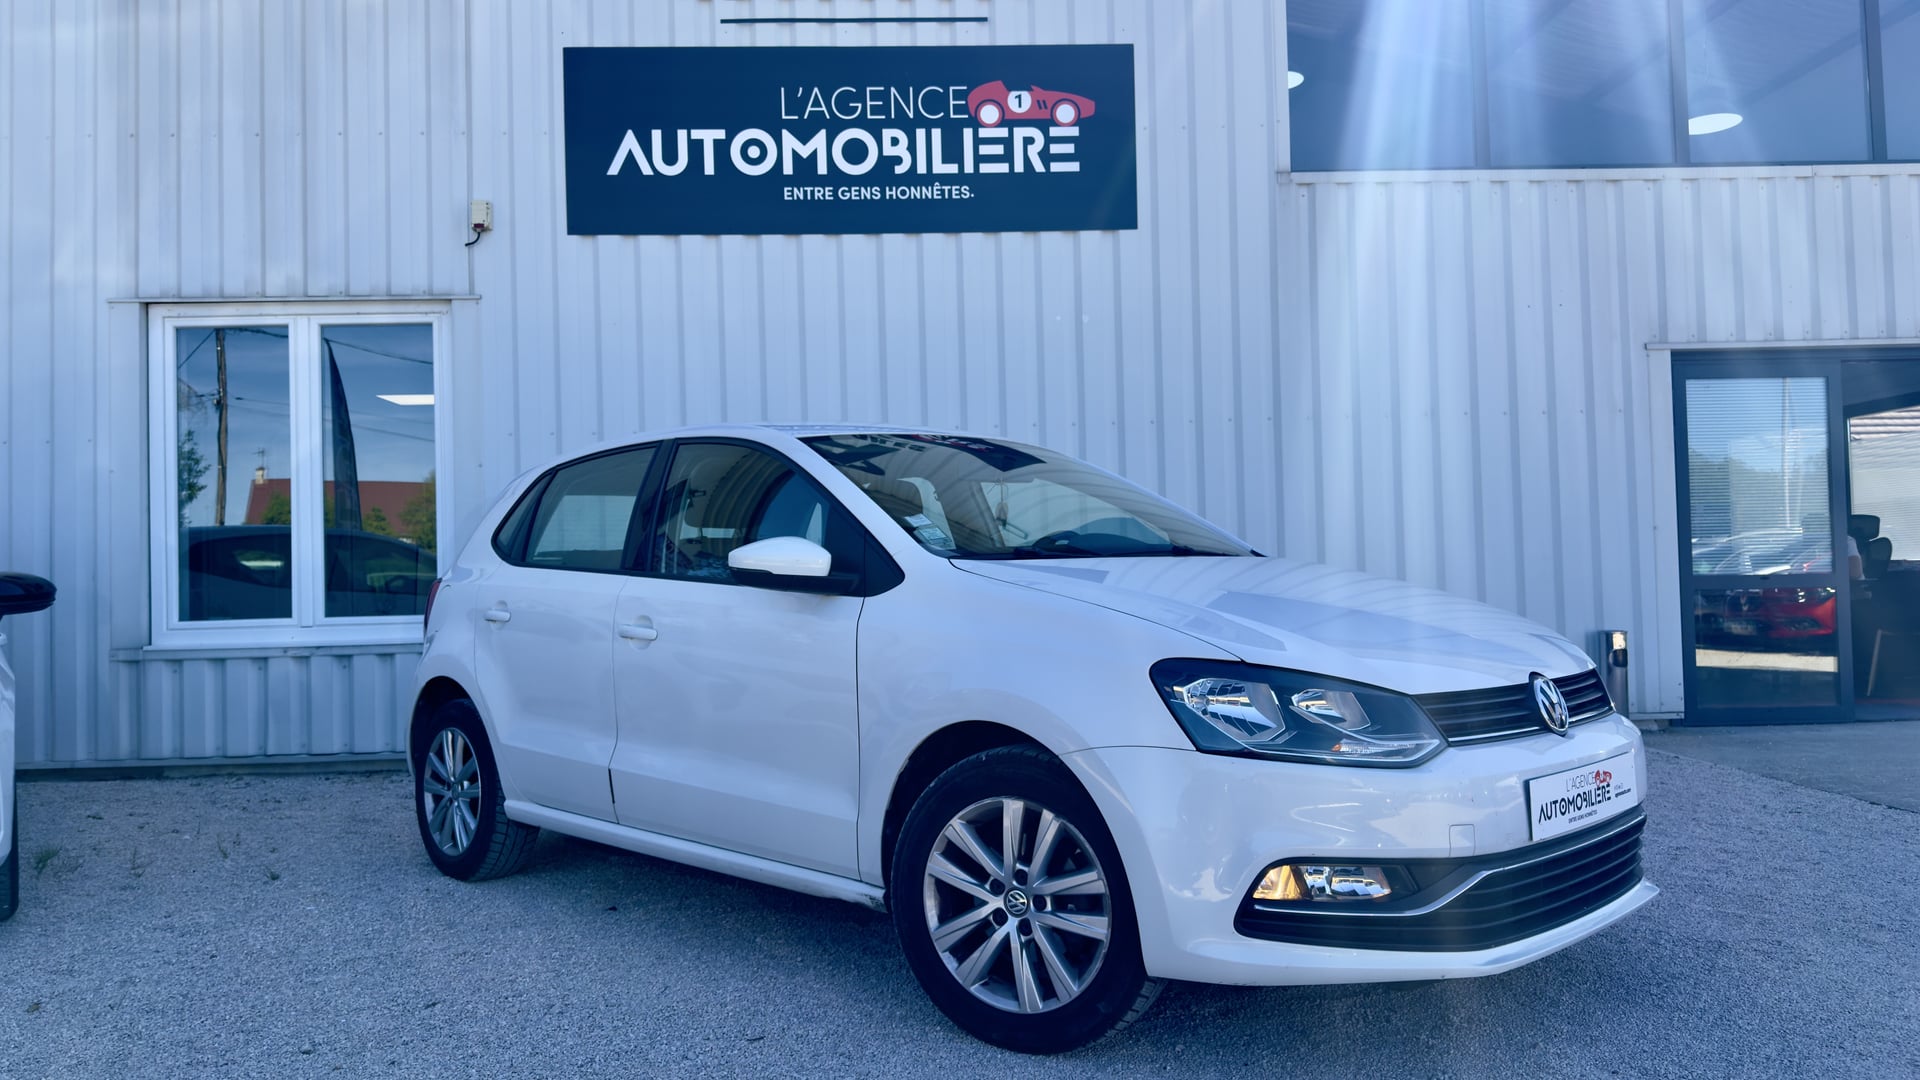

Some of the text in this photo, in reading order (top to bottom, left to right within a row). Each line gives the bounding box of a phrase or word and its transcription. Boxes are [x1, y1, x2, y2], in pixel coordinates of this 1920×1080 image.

[781, 86, 969, 120] L'AGENCE
[1014, 93, 1023, 109] 1
[784, 182, 975, 200] ENTRE GENS HONNÊTES.
